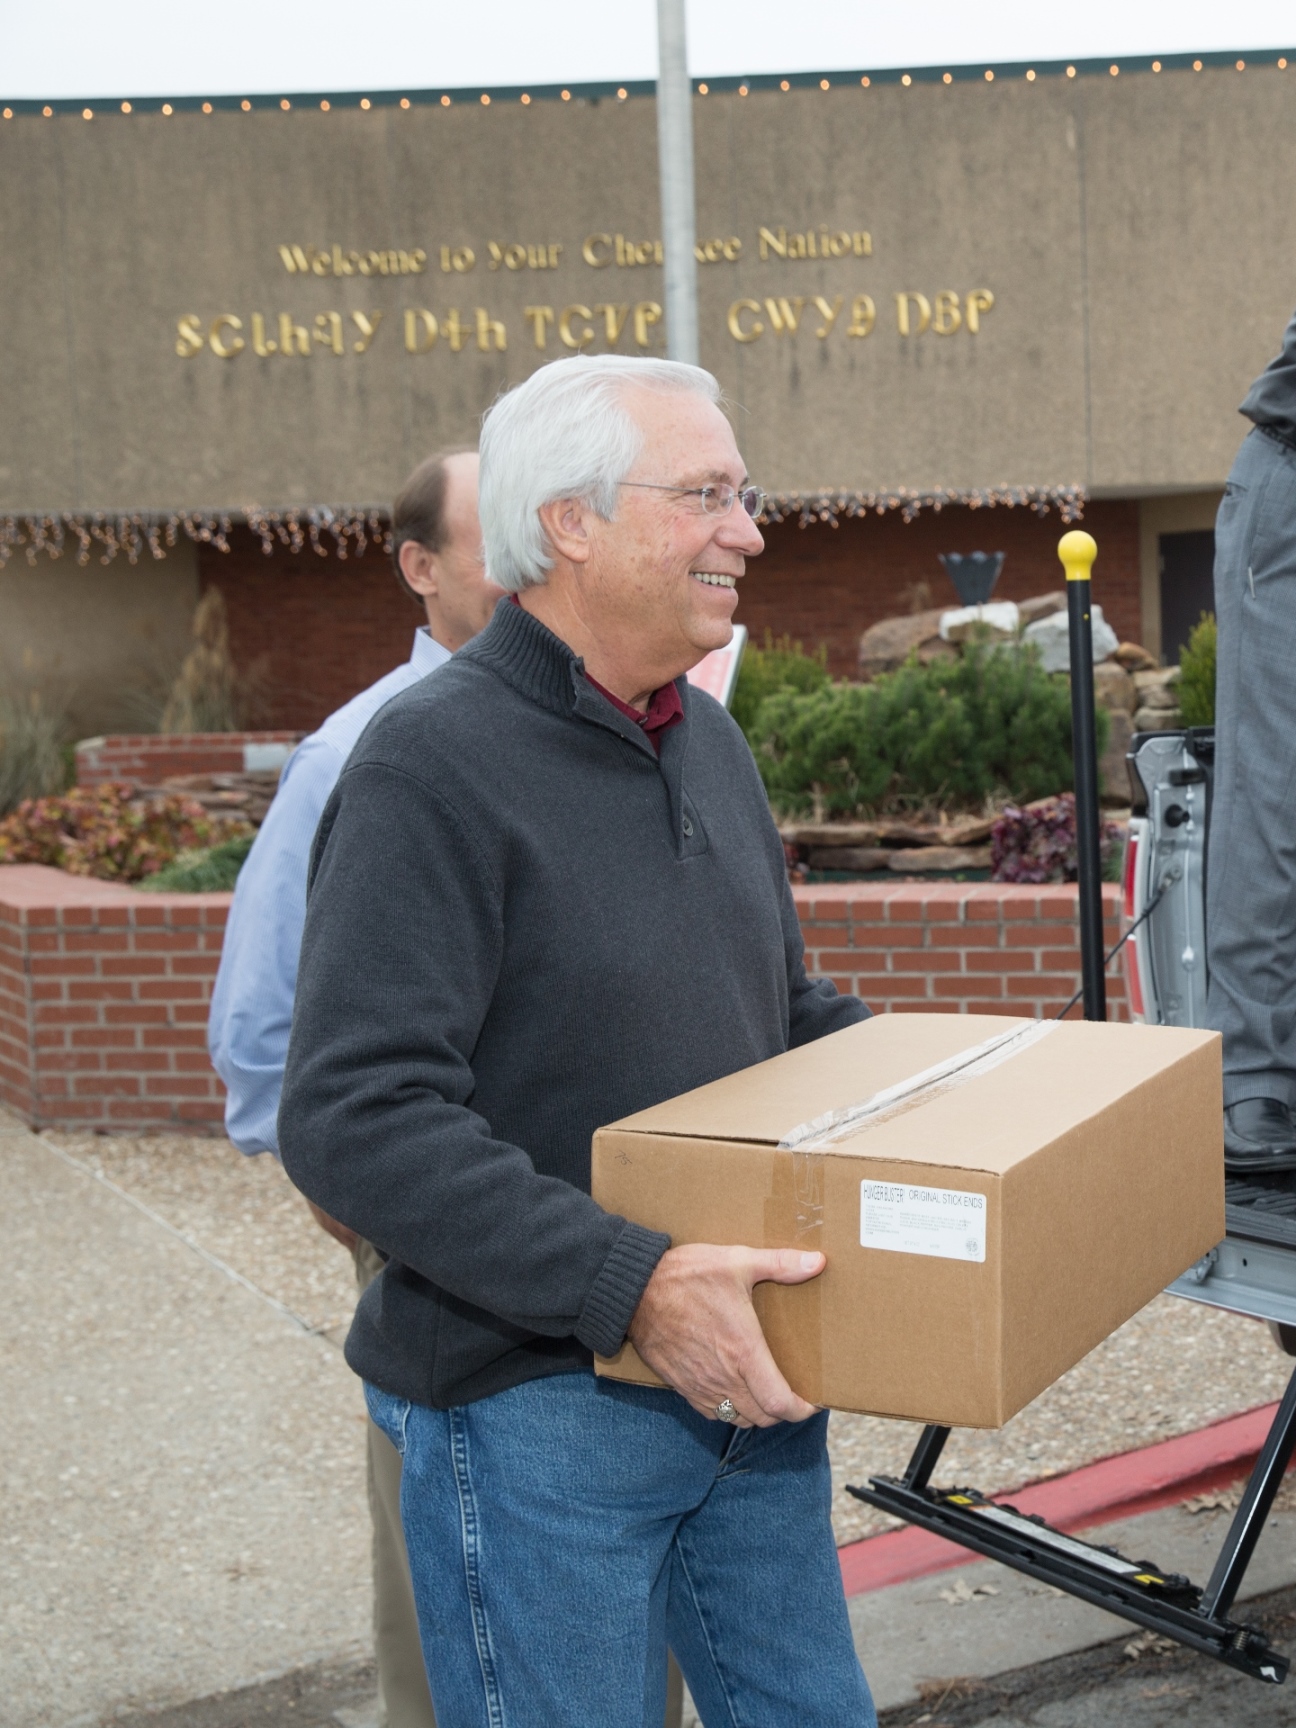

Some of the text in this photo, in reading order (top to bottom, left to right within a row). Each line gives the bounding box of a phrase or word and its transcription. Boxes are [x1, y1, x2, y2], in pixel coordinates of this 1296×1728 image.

[278, 239, 428, 276] Welcome
[440, 243, 476, 274] to
[758, 222, 873, 261] Nation
[863, 1184, 884, 1201] HUNGER
[908, 1189, 941, 1204] ORIGINAL
[942, 1193, 962, 1206] STICK
[963, 1196, 983, 1209] ENDS
